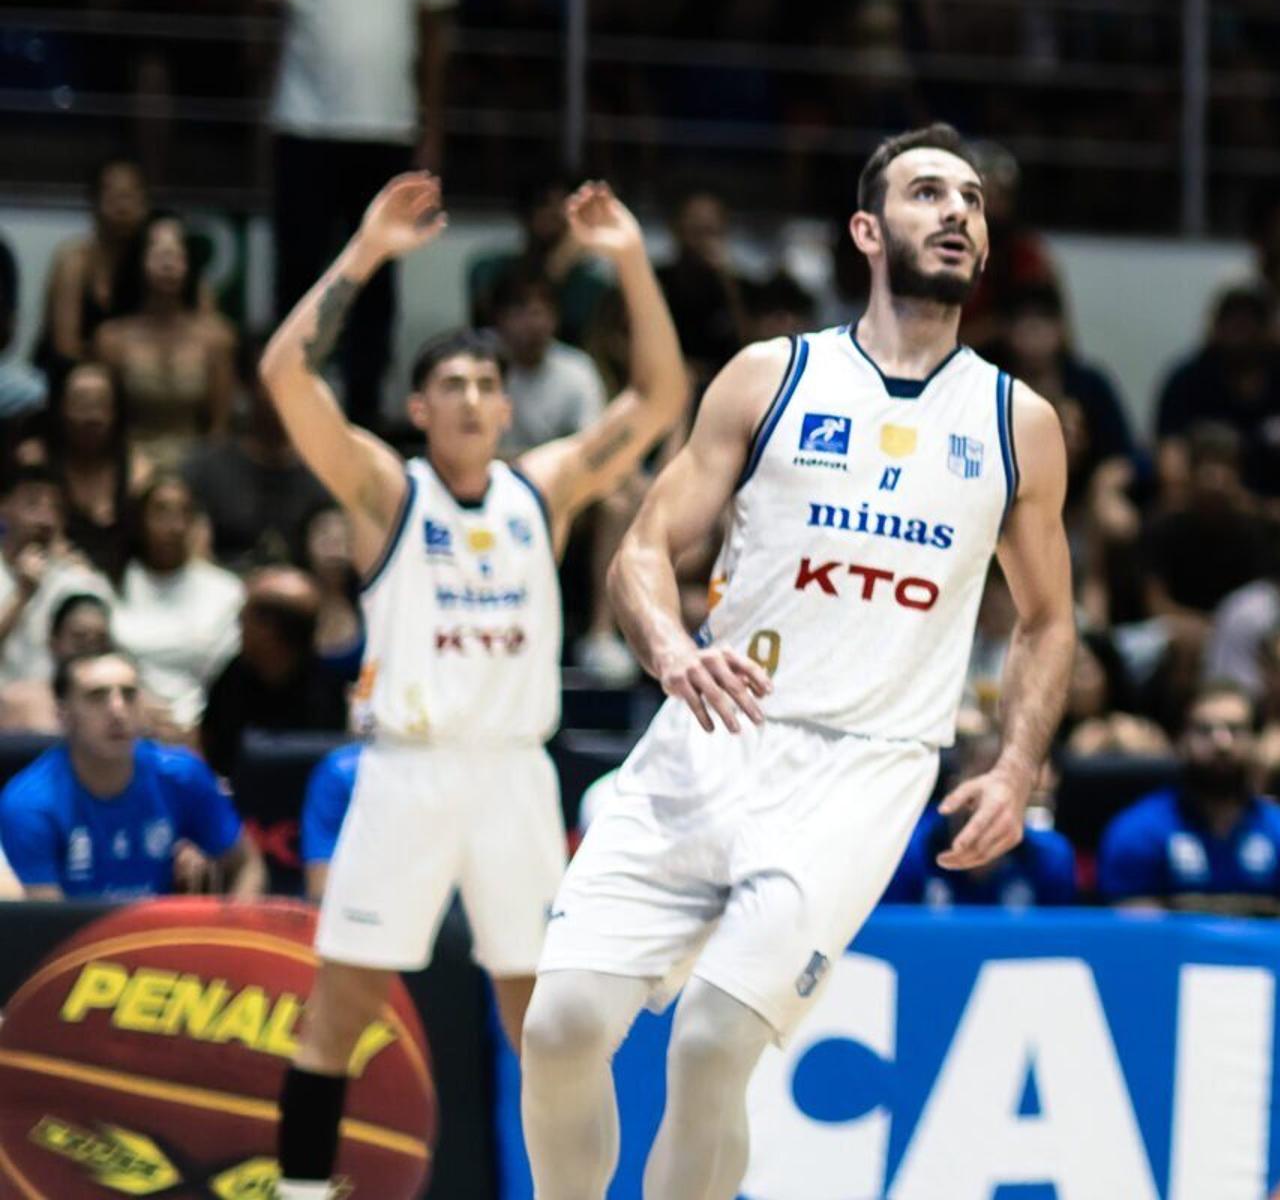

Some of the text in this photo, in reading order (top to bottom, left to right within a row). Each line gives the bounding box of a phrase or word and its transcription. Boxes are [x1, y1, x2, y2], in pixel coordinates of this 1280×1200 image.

[807, 500, 955, 550] minas
[794, 557, 940, 612] KTO
[62, 961, 399, 1079] PENALY
